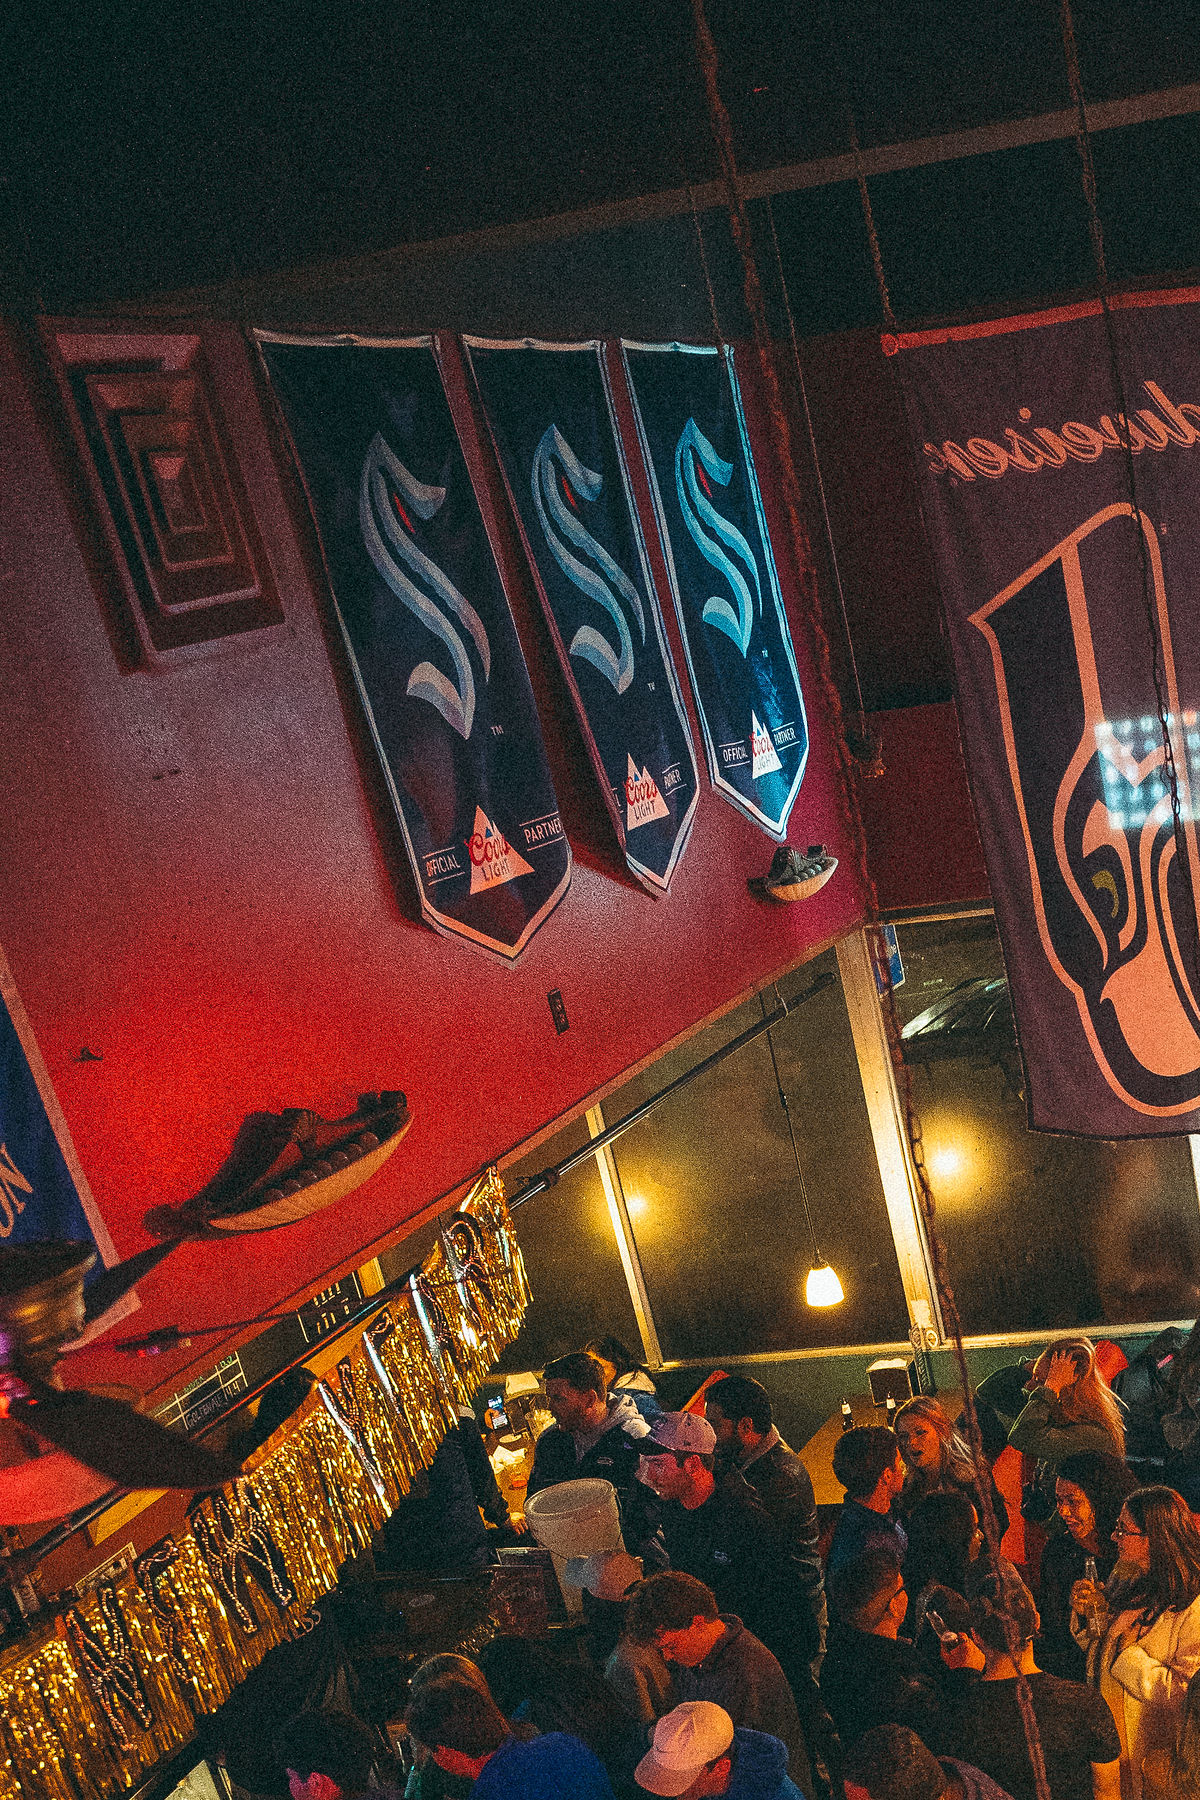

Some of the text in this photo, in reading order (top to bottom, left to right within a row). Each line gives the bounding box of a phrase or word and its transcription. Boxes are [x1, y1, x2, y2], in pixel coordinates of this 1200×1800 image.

[624, 776, 659, 806] Coors
[634, 800, 656, 821] LIGHT
[426, 854, 461, 877] OFFICIAL
[483, 857, 511, 882] LIGHT
